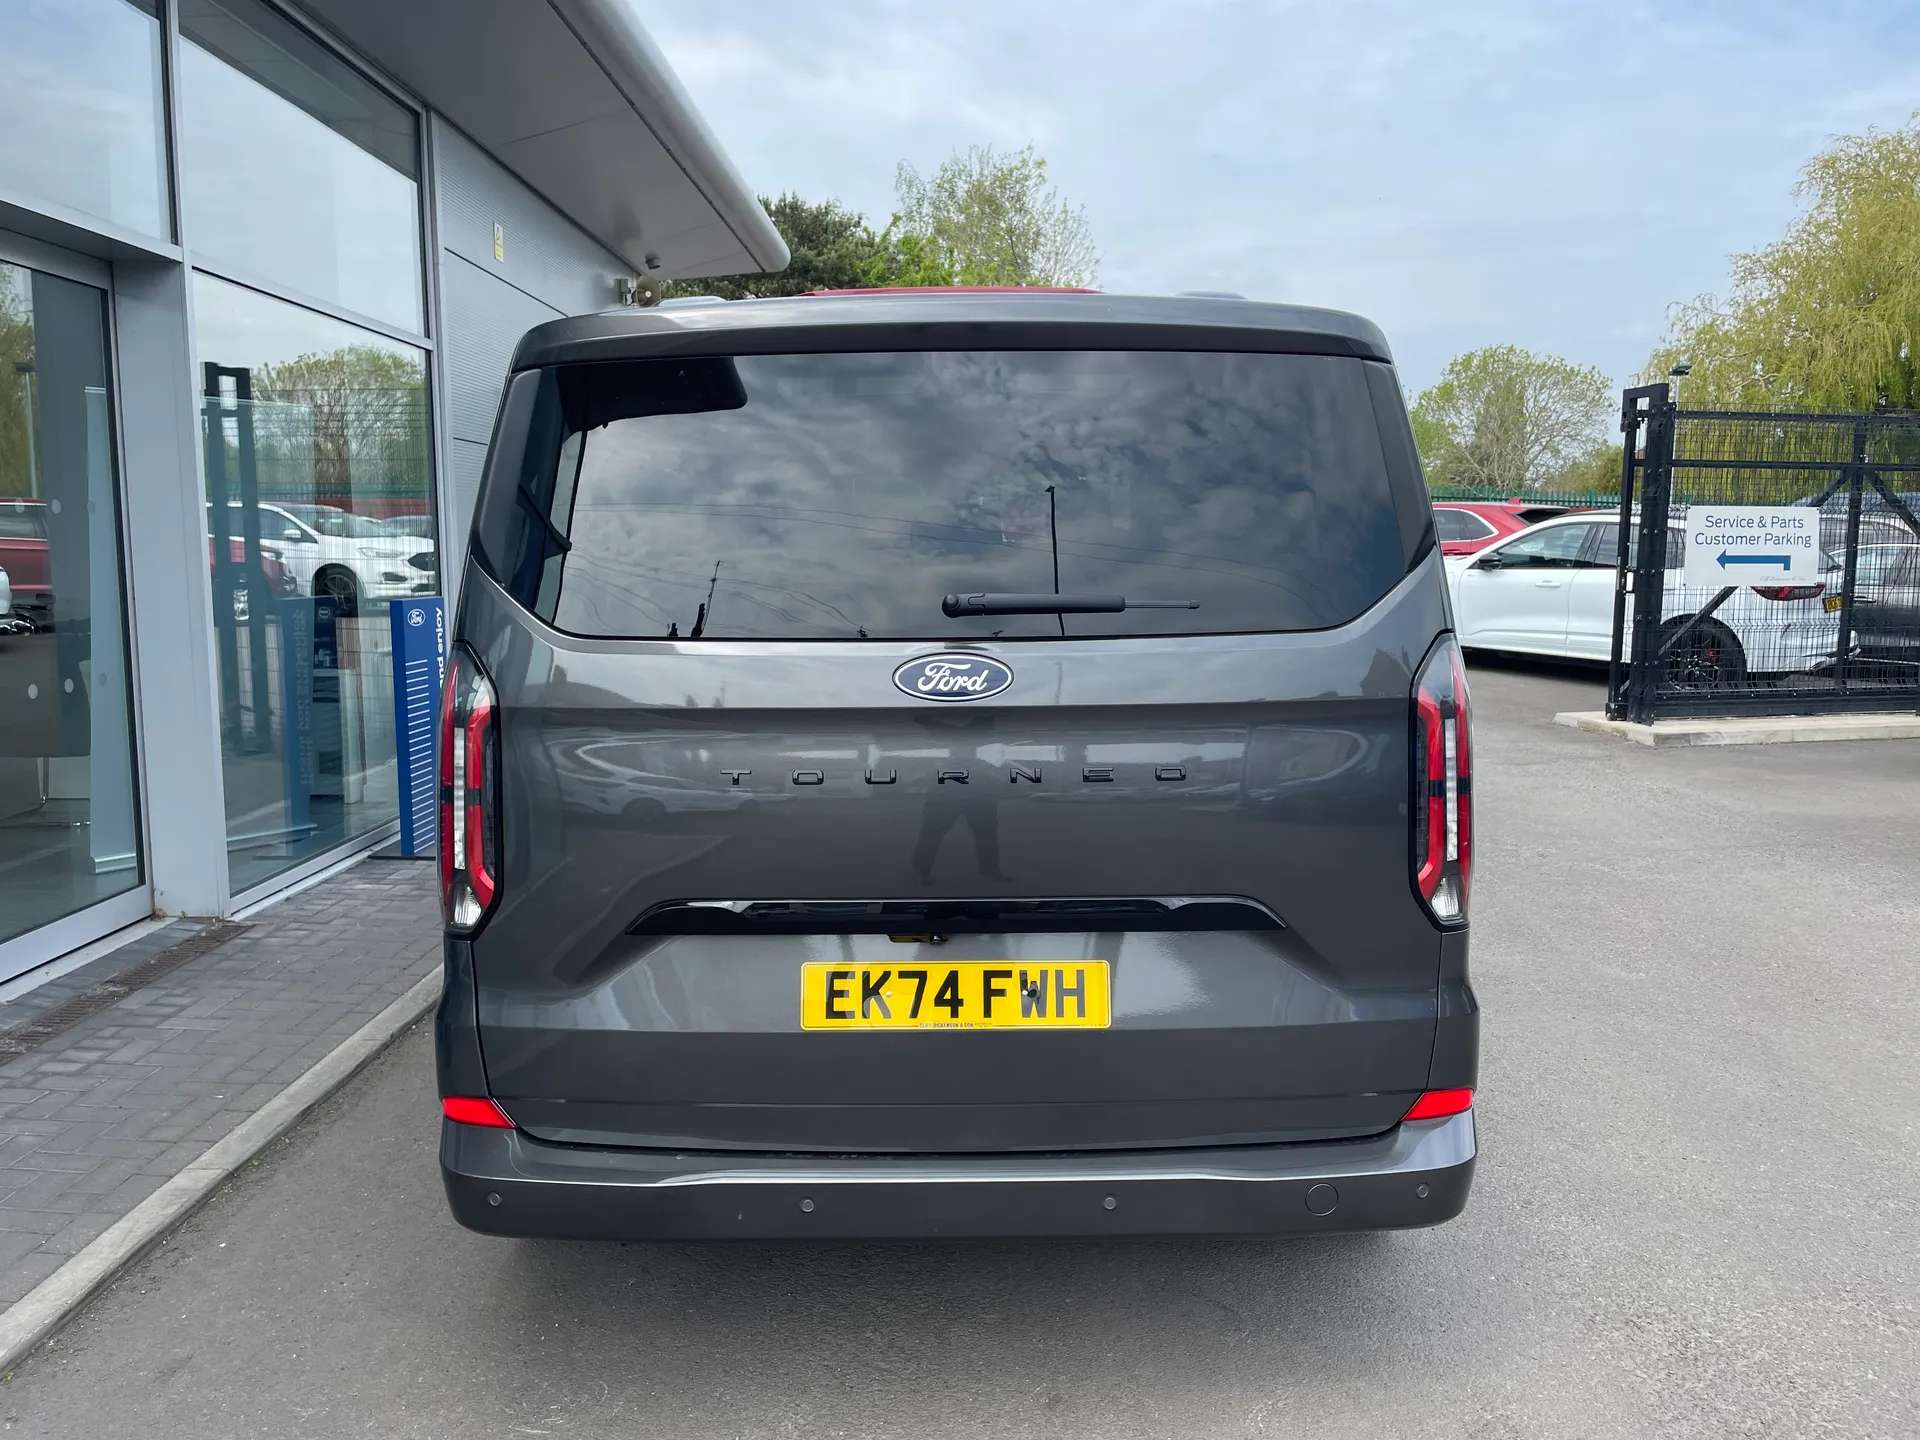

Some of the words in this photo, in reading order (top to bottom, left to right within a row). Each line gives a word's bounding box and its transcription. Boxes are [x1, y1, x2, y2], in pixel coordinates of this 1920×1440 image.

[1705, 515, 1754, 528] Service
[1757, 515, 1767, 528] &
[1771, 515, 1804, 528] Parts
[1695, 532, 1761, 545] Customer
[1764, 532, 1812, 548] Parking
[435, 607, 444, 653] enjoy
[917, 662, 989, 691] Ford
[720, 767, 1186, 785] TOURNEO
[825, 970, 964, 1019] EK74
[983, 969, 1086, 1018] FWH
